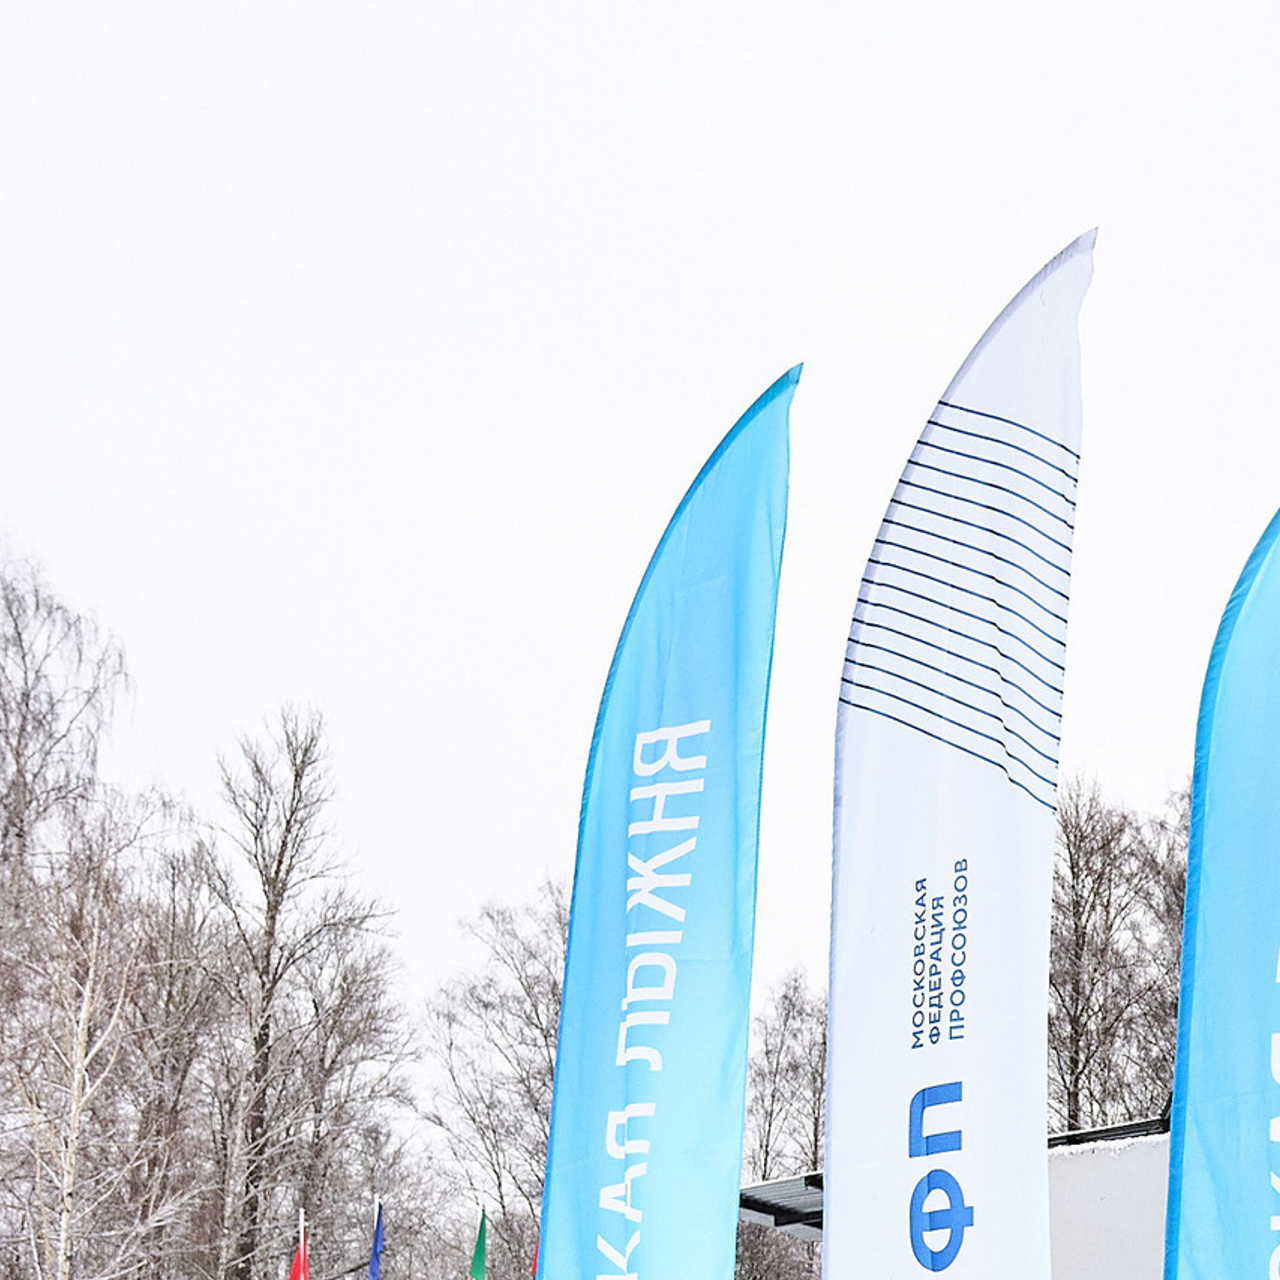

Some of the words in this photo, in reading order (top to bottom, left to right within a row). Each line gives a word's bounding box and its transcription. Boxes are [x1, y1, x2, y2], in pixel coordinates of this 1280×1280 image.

[615, 720, 711, 1071] ЛЫЖНЯ
[911, 877, 927, 1050] МОСКОВСКАЯ
[928, 895, 946, 1045] ФЕДЕРАЦИЯ
[949, 857, 968, 1041] ПРОФСОЮЗОВ
